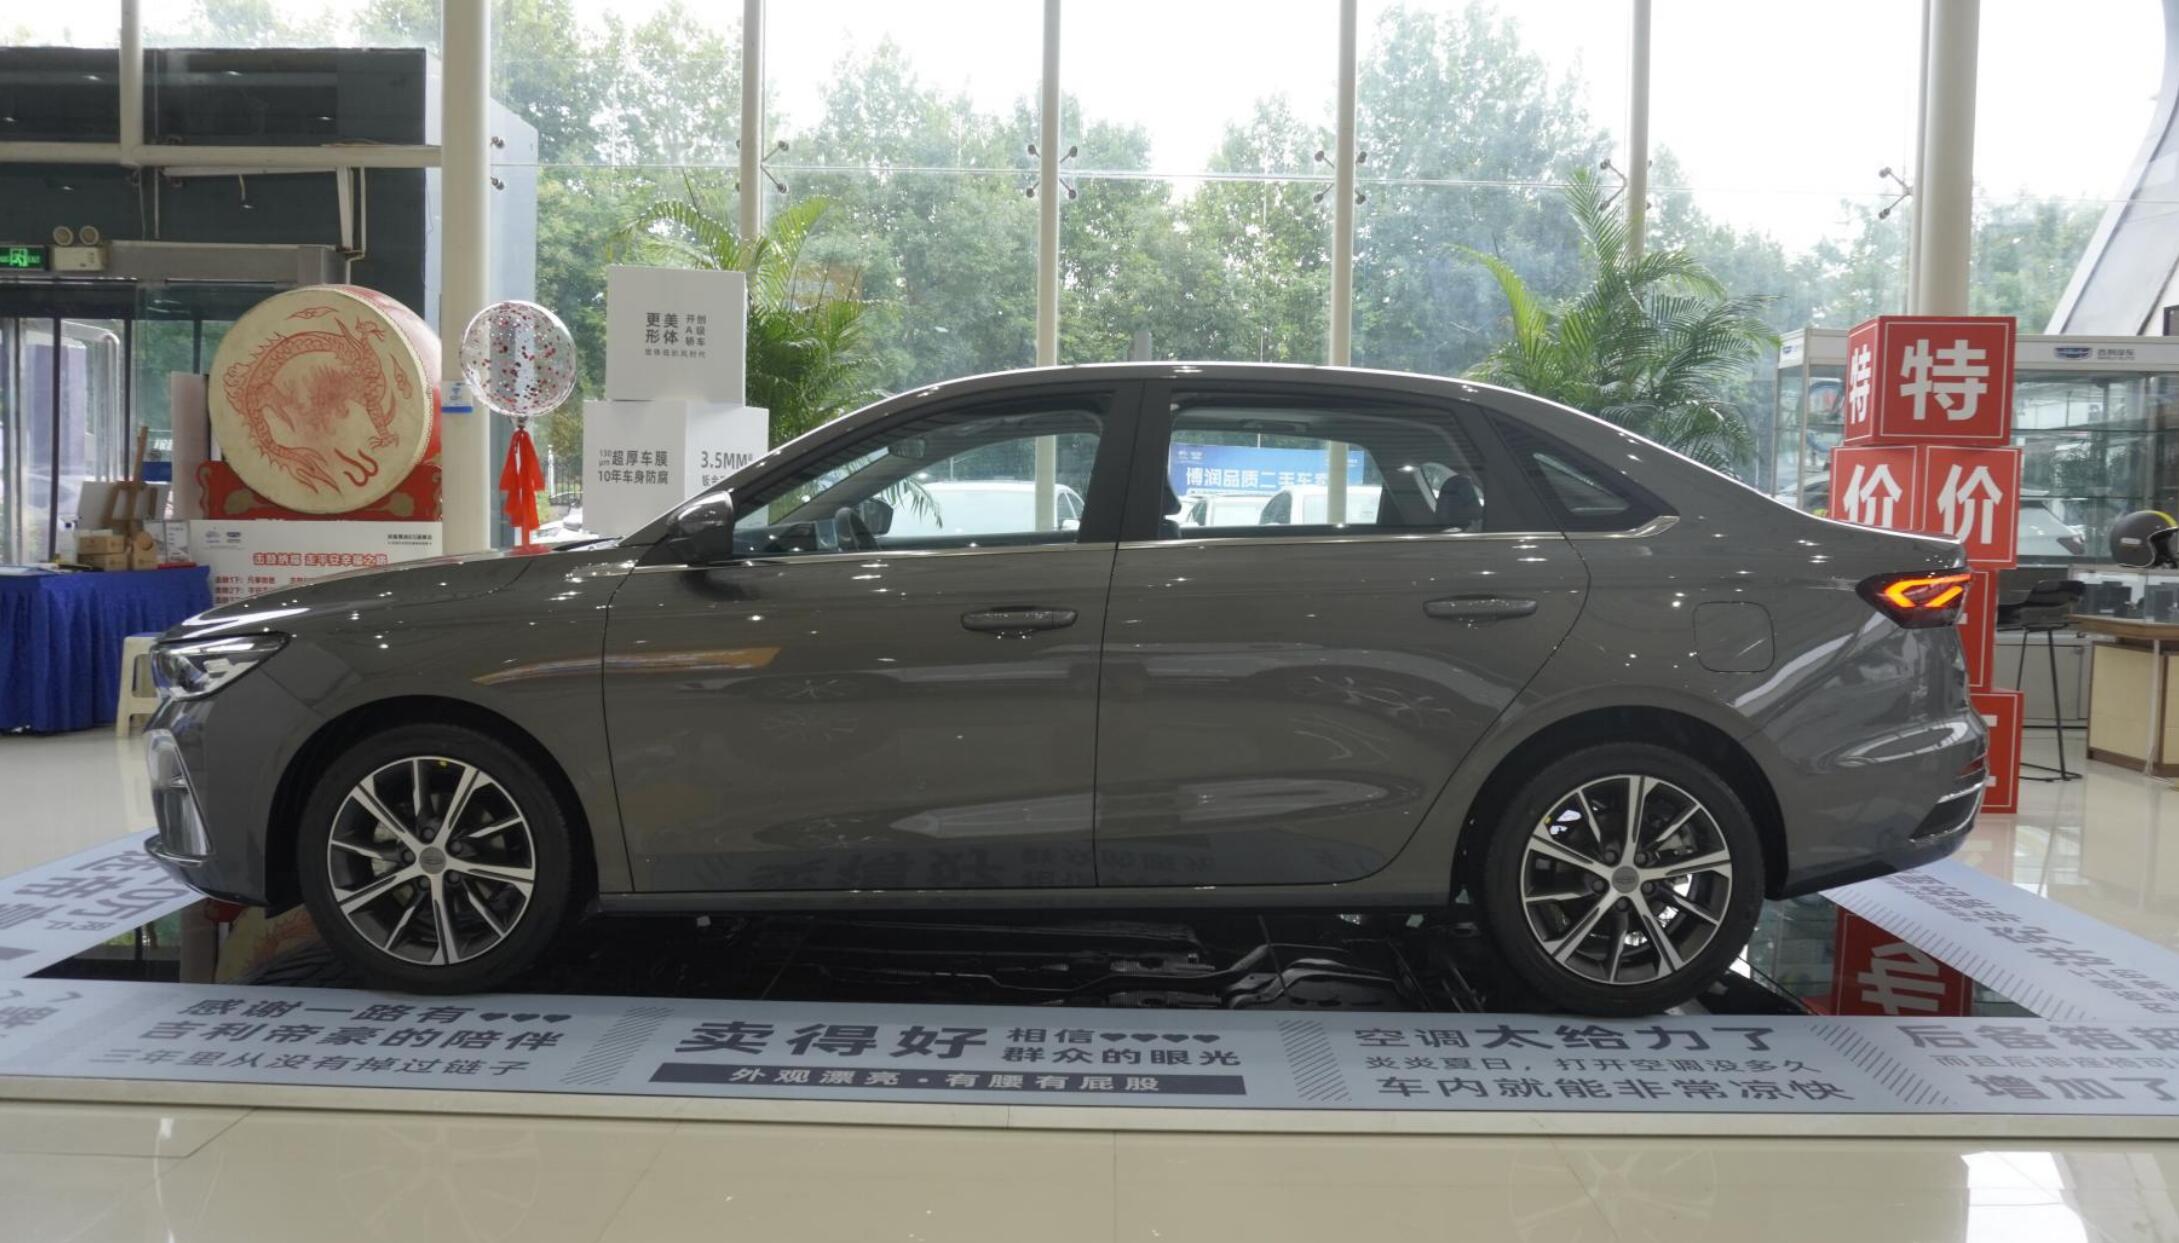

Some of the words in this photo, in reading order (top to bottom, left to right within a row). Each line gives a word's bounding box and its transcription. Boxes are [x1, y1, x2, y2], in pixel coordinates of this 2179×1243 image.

[646, 312, 678, 328] 更美
[646, 329, 679, 344] 形体
[1850, 344, 1871, 424] 特
[1900, 338, 1989, 421] 特
[1844, 464, 1902, 528] 价
[1937, 464, 2003, 545] 价
[177, 998, 475, 1024] 感谢一路有
[138, 1020, 564, 1050] 吉利帝豪的陪伴
[674, 1021, 988, 1059] 卖得好
[1007, 1028, 1096, 1044] 相信
[1355, 1024, 1774, 1051] 空调太给力了
[90, 1048, 530, 1076] 三年里从没有掉过链子
[1002, 1047, 1241, 1066] 群众的眼光
[1377, 1076, 1856, 1100] 车内就能非常凉快
[1967, 1074, 2177, 1101] 增加了
